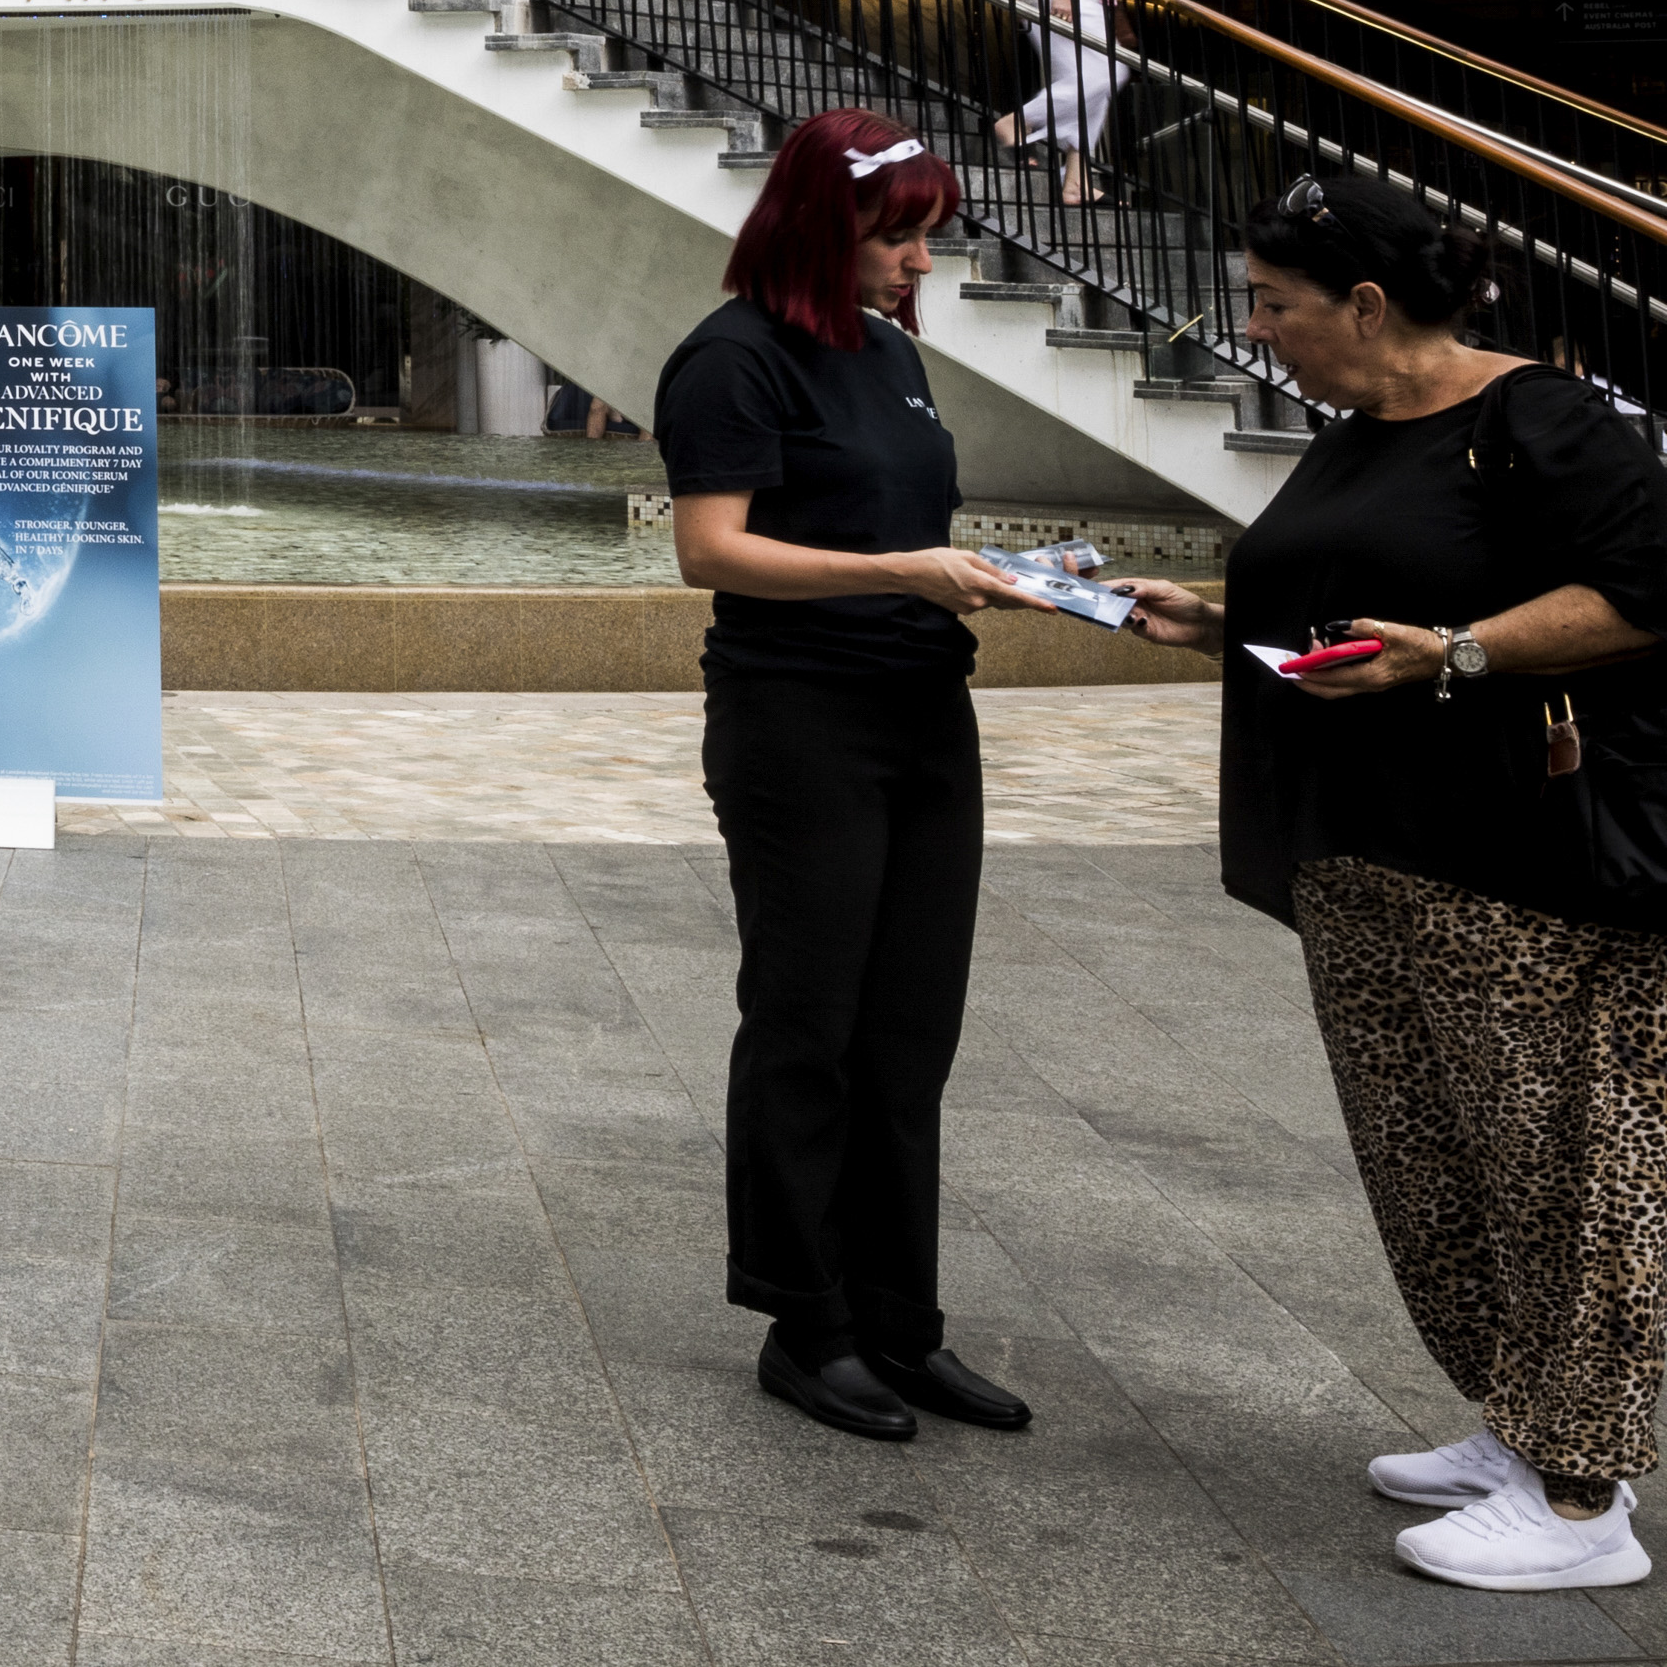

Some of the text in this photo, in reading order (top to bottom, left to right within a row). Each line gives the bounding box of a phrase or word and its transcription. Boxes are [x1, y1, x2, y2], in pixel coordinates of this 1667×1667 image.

[8, 357, 95, 368] ONE WEEK
[30, 372, 71, 382] WITH
[1, 385, 103, 401] ADVANCED
[14, 444, 60, 454] LOYALTY
[62, 445, 116, 455] PROGRAM
[118, 446, 143, 456] AND
[9, 457, 17, 466] A
[18, 457, 111, 468] COMPLIMENTARY
[113, 459, 118, 468] 7
[121, 459, 143, 468] DAY
[10, 470, 24, 479] OF
[26, 470, 50, 480] OUR
[52, 471, 91, 480] ICONIC
[92, 471, 128, 481] SERUM
[15, 520, 129, 531] STRONGER, YOUNGER,
[15, 532, 144, 544] HEALTHY LOOKING SKIN.
[15, 545, 63, 555] IN 7 DAYS
